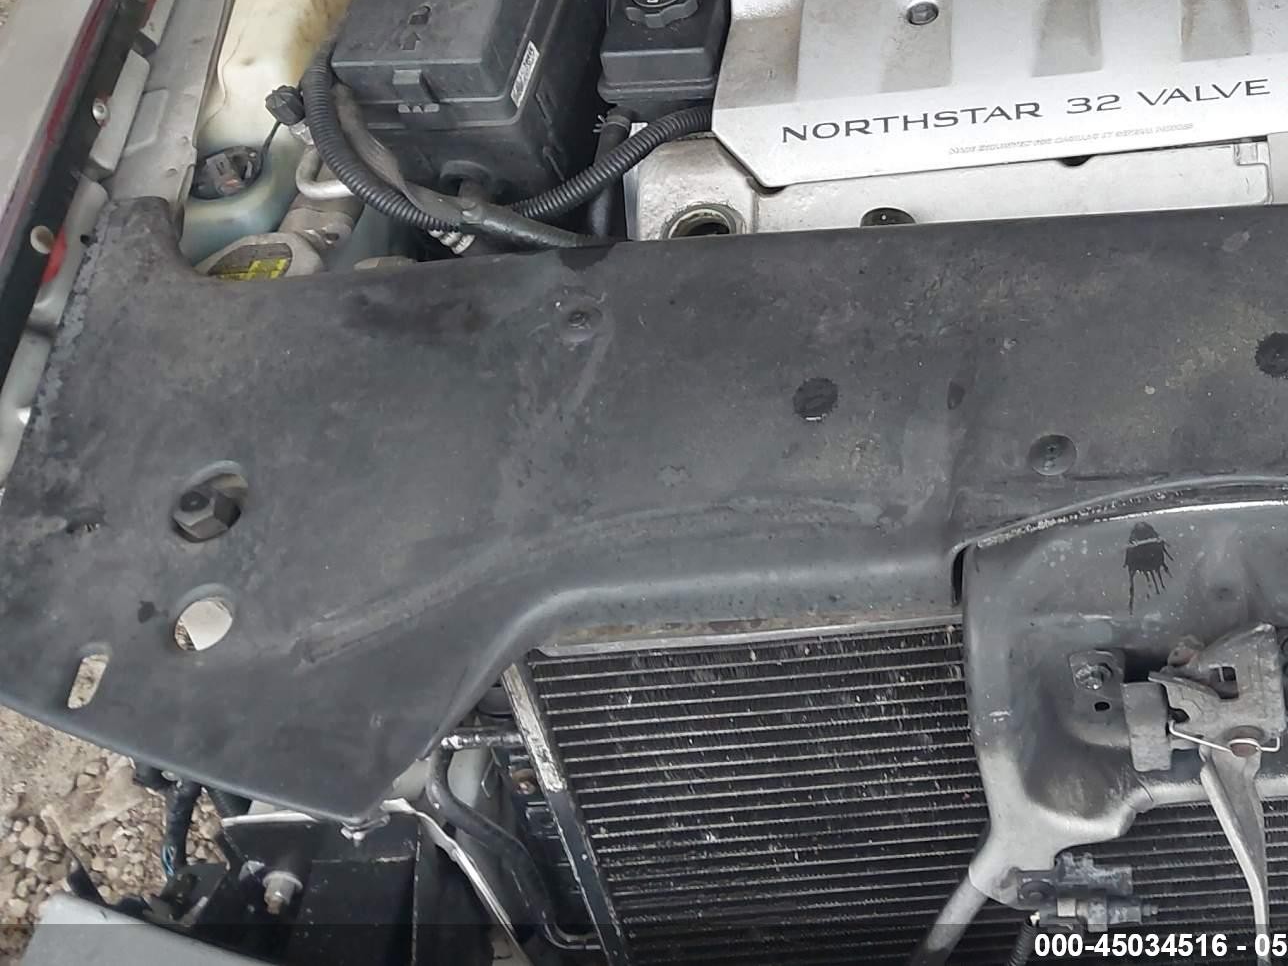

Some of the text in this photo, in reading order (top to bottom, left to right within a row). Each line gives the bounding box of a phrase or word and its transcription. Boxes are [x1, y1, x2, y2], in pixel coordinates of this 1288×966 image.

[781, 101, 1043, 143] NORTHSTAR
[1065, 94, 1122, 115] 32
[1137, 78, 1271, 106] VALVE
